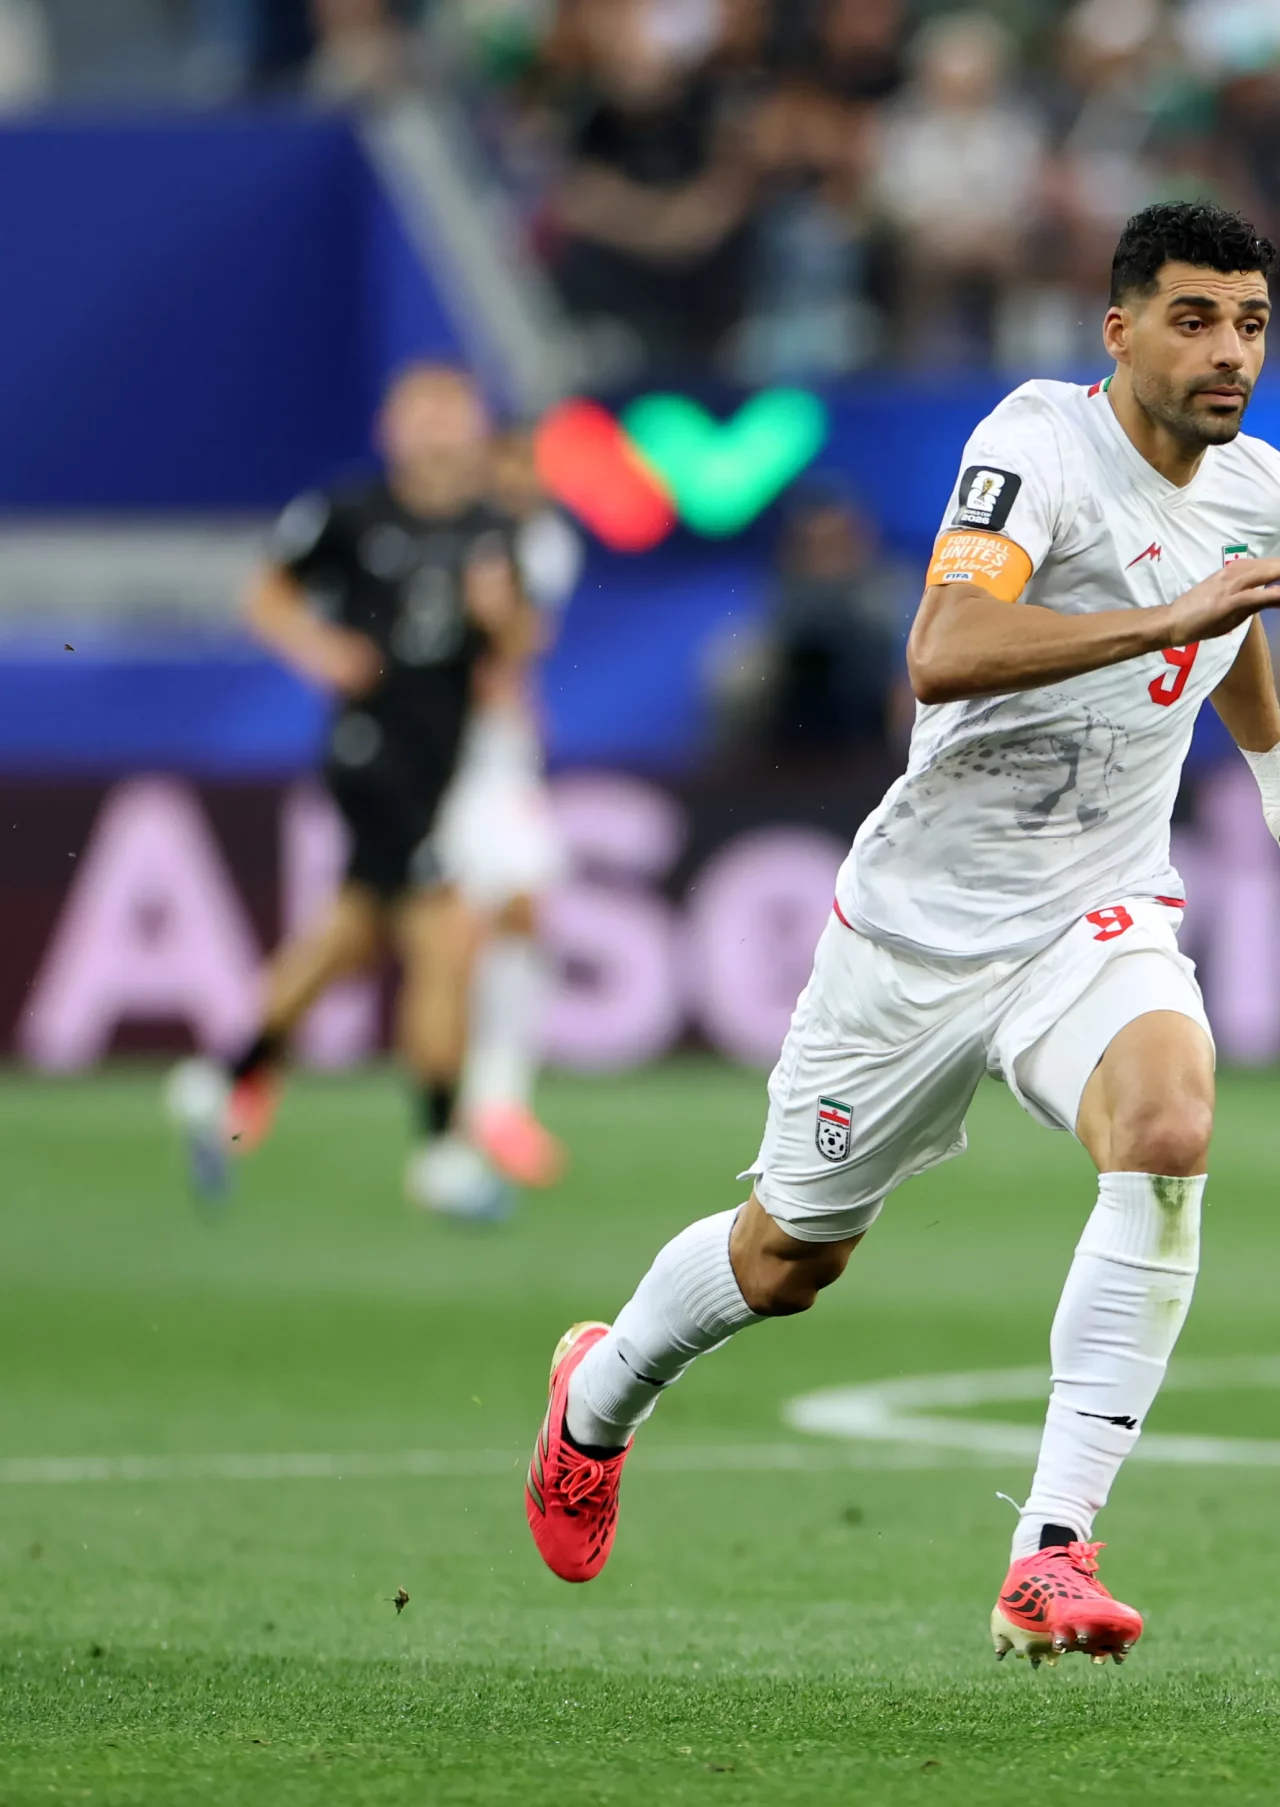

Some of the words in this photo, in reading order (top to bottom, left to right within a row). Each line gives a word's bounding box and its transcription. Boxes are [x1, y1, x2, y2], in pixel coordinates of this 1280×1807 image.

[960, 513, 990, 525] 2026
[939, 545, 1008, 567] UNITES
[945, 536, 1009, 556] FOOTBALL
[953, 559, 1003, 580] World
[1148, 640, 1200, 707] 9
[1085, 905, 1134, 941] 9
